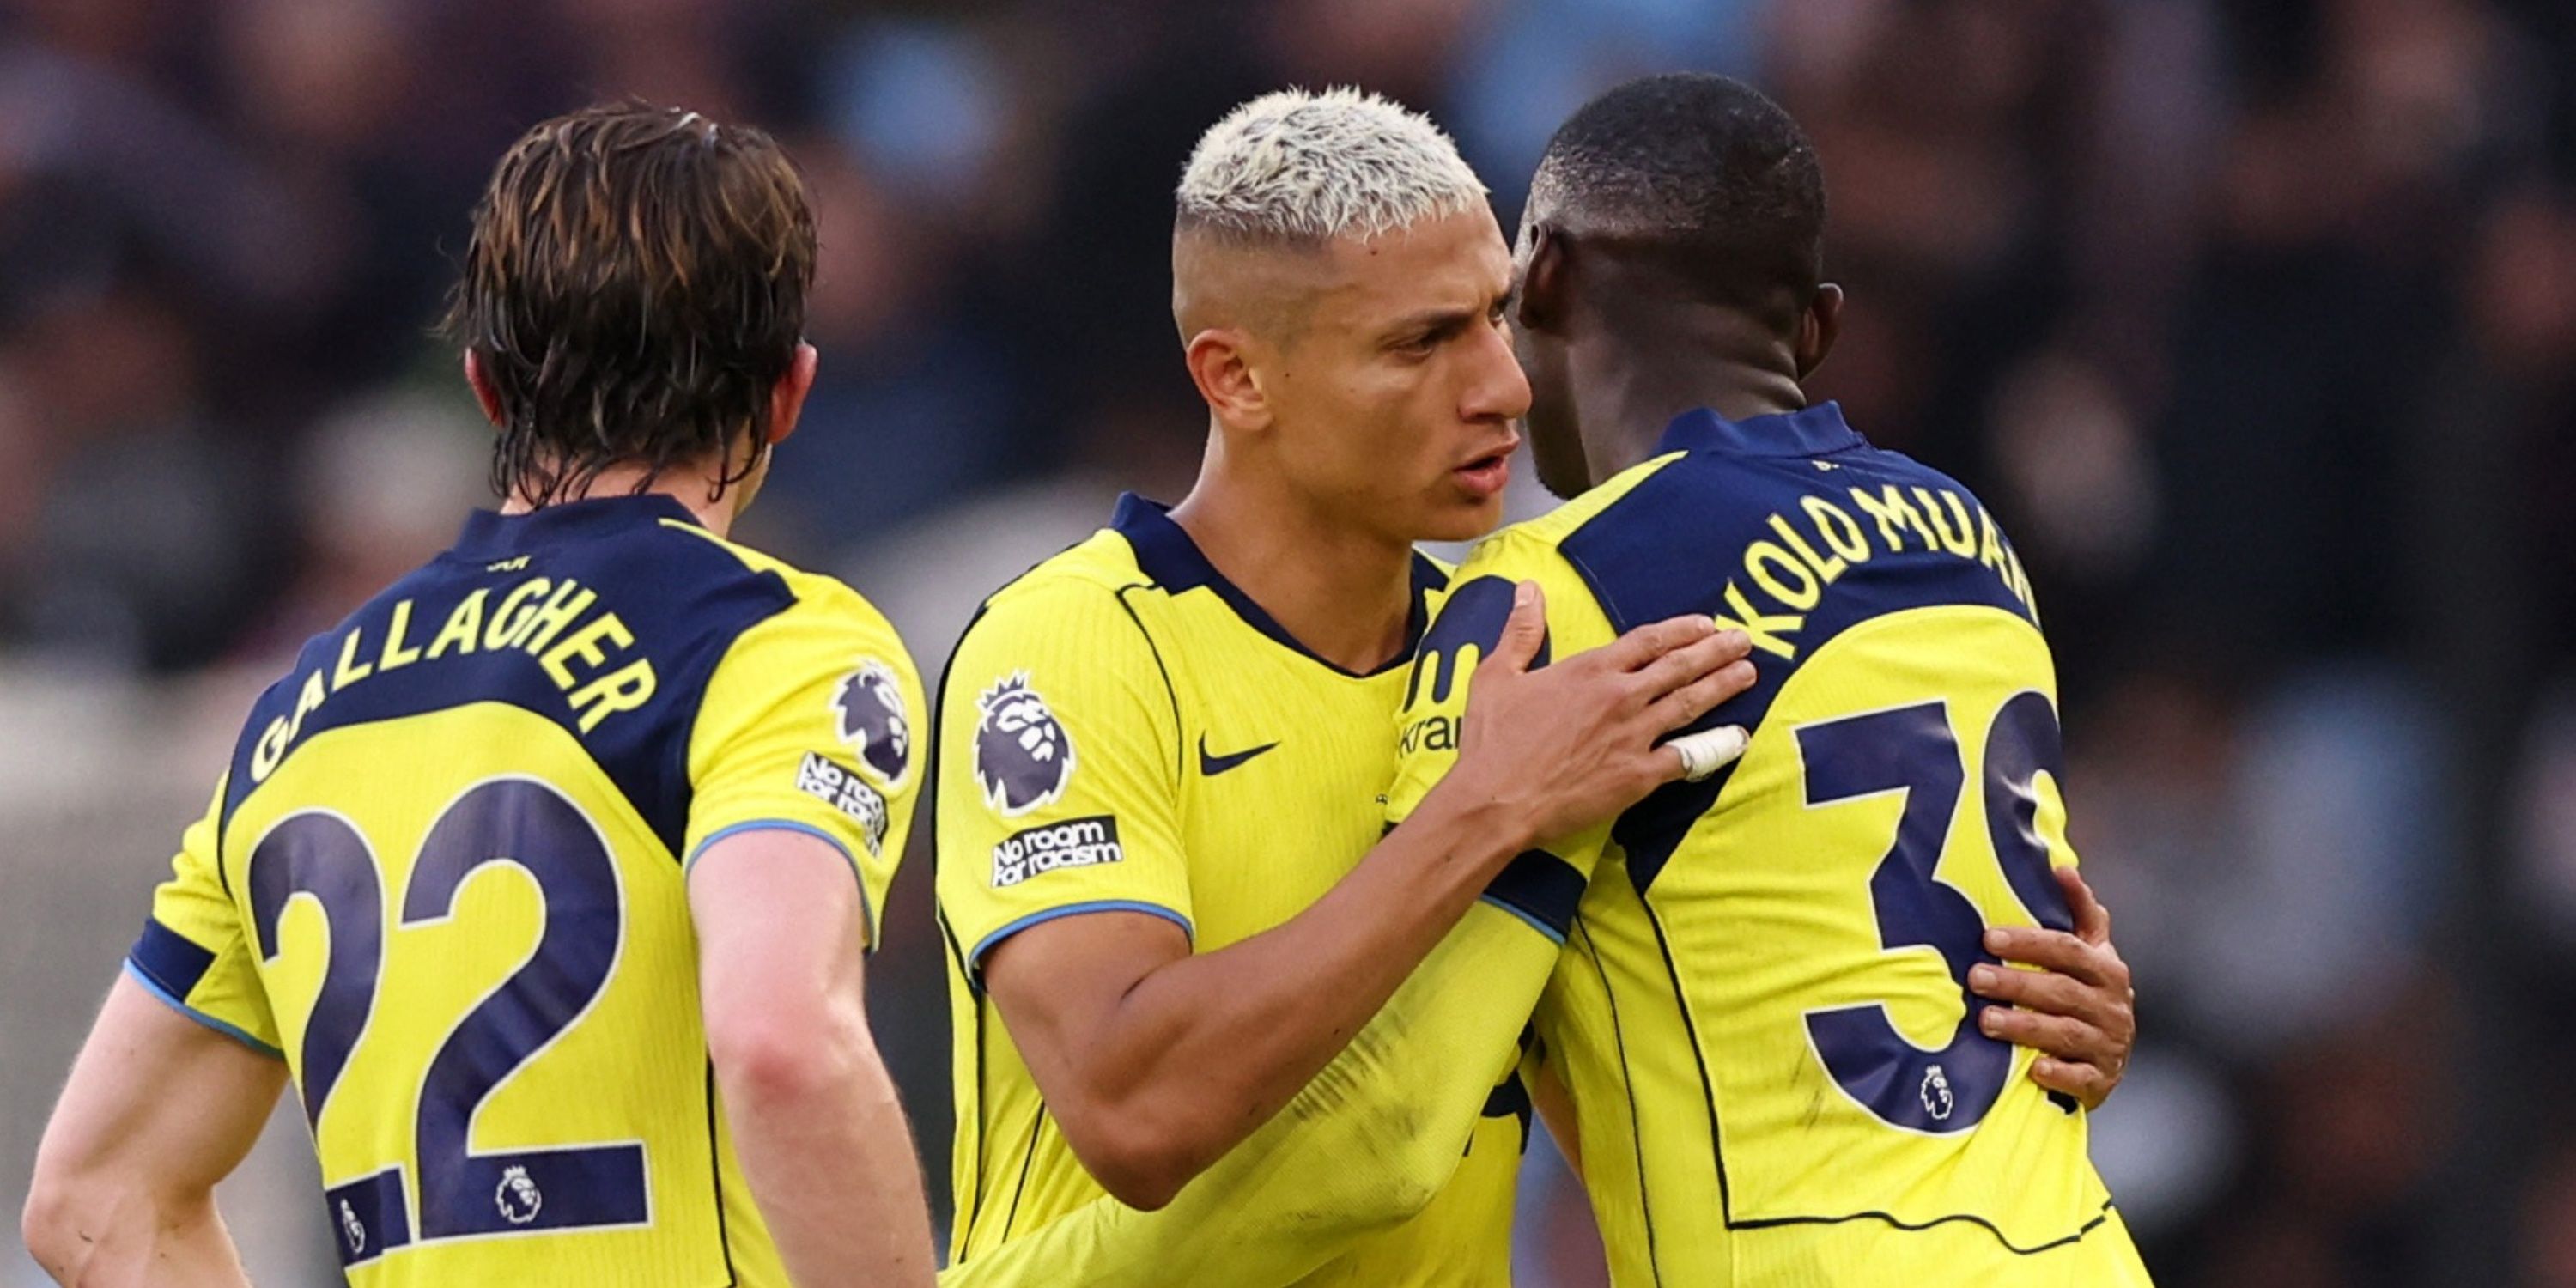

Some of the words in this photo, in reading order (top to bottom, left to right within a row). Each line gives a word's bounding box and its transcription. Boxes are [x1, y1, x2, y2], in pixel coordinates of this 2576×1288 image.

[1715, 495, 1872, 660] KOLO
[252, 577, 658, 783] GALLAGHER
[800, 751, 843, 787] No
[992, 860, 1026, 888] for
[1028, 841, 1123, 876] racism
[993, 839, 1024, 866] No
[1024, 821, 1105, 854] room
[247, 772, 654, 1268] 22
